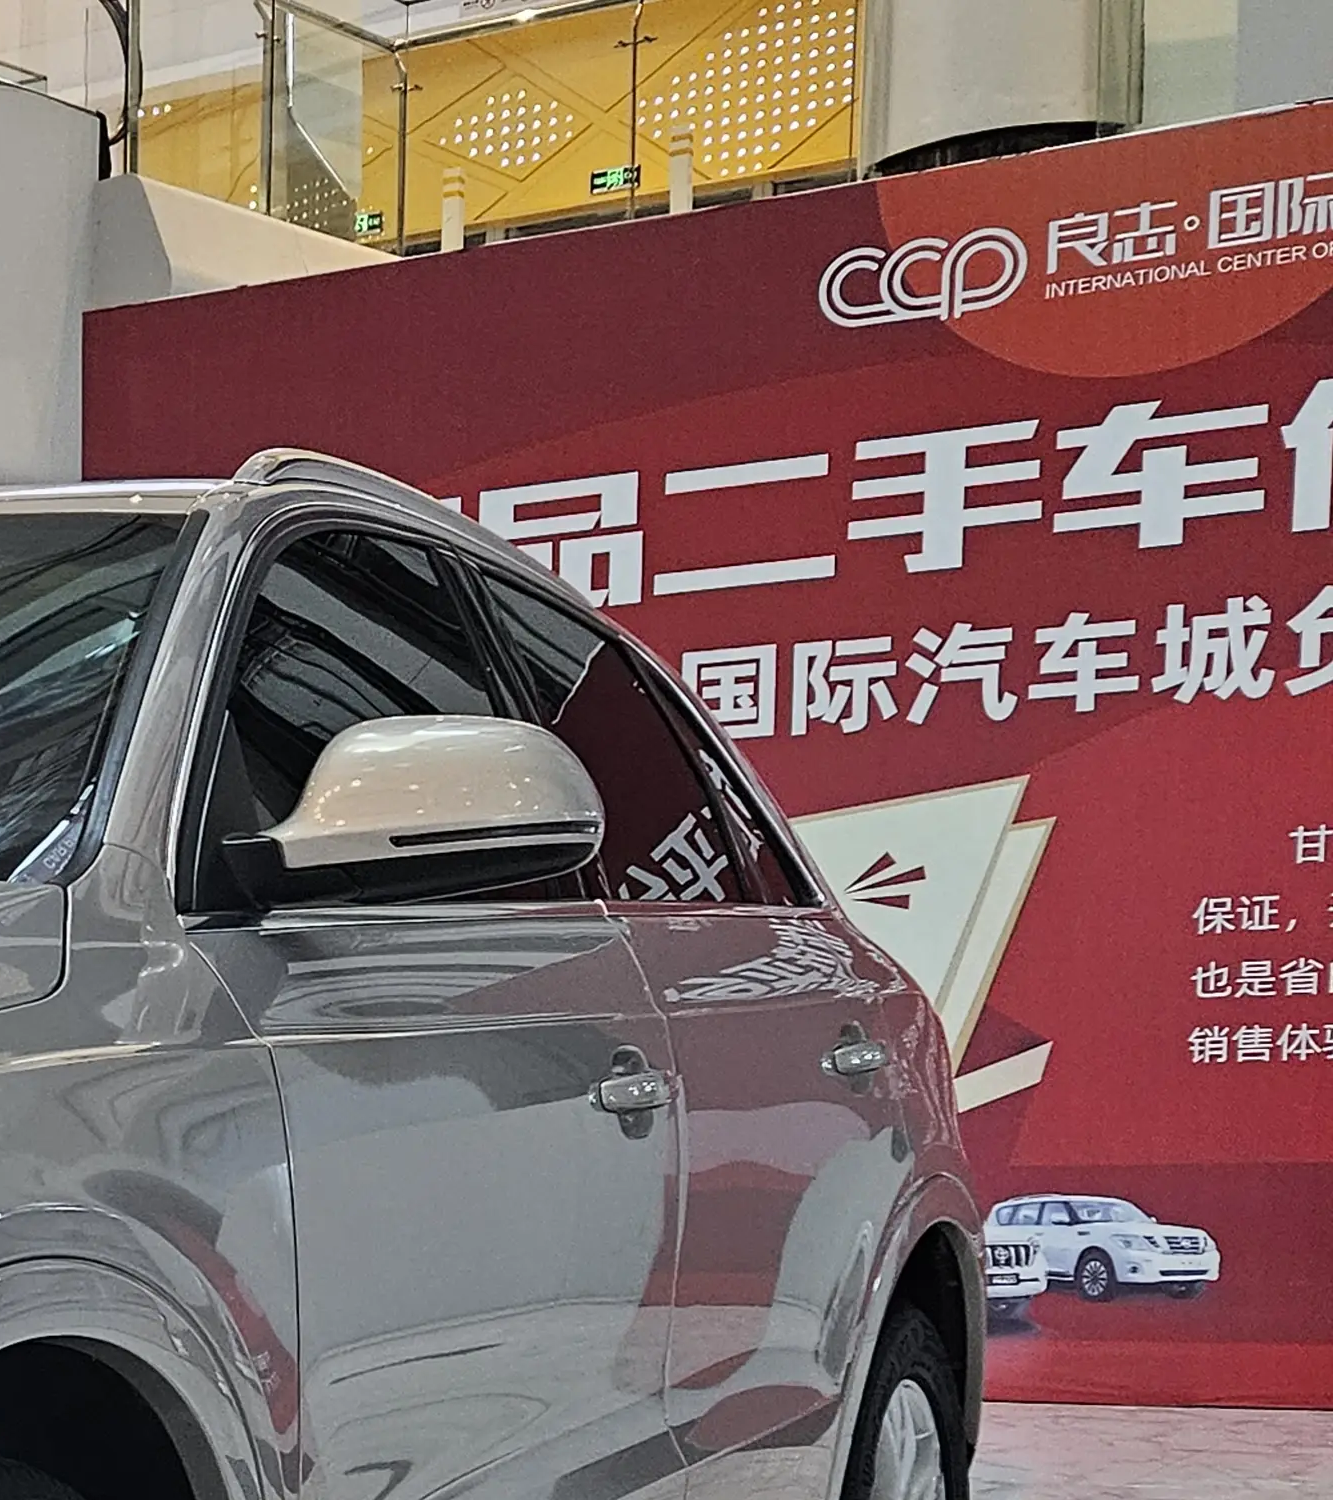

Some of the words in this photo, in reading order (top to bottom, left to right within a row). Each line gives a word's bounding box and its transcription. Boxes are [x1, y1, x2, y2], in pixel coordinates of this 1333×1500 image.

[1044, 260, 1212, 299] INTERNATIONAL
[1217, 245, 1307, 275] CENTER
[418, 380, 1333, 607] 品二手车
[1192, 894, 1333, 935] 保证，
[1190, 957, 1333, 999] 也是省
